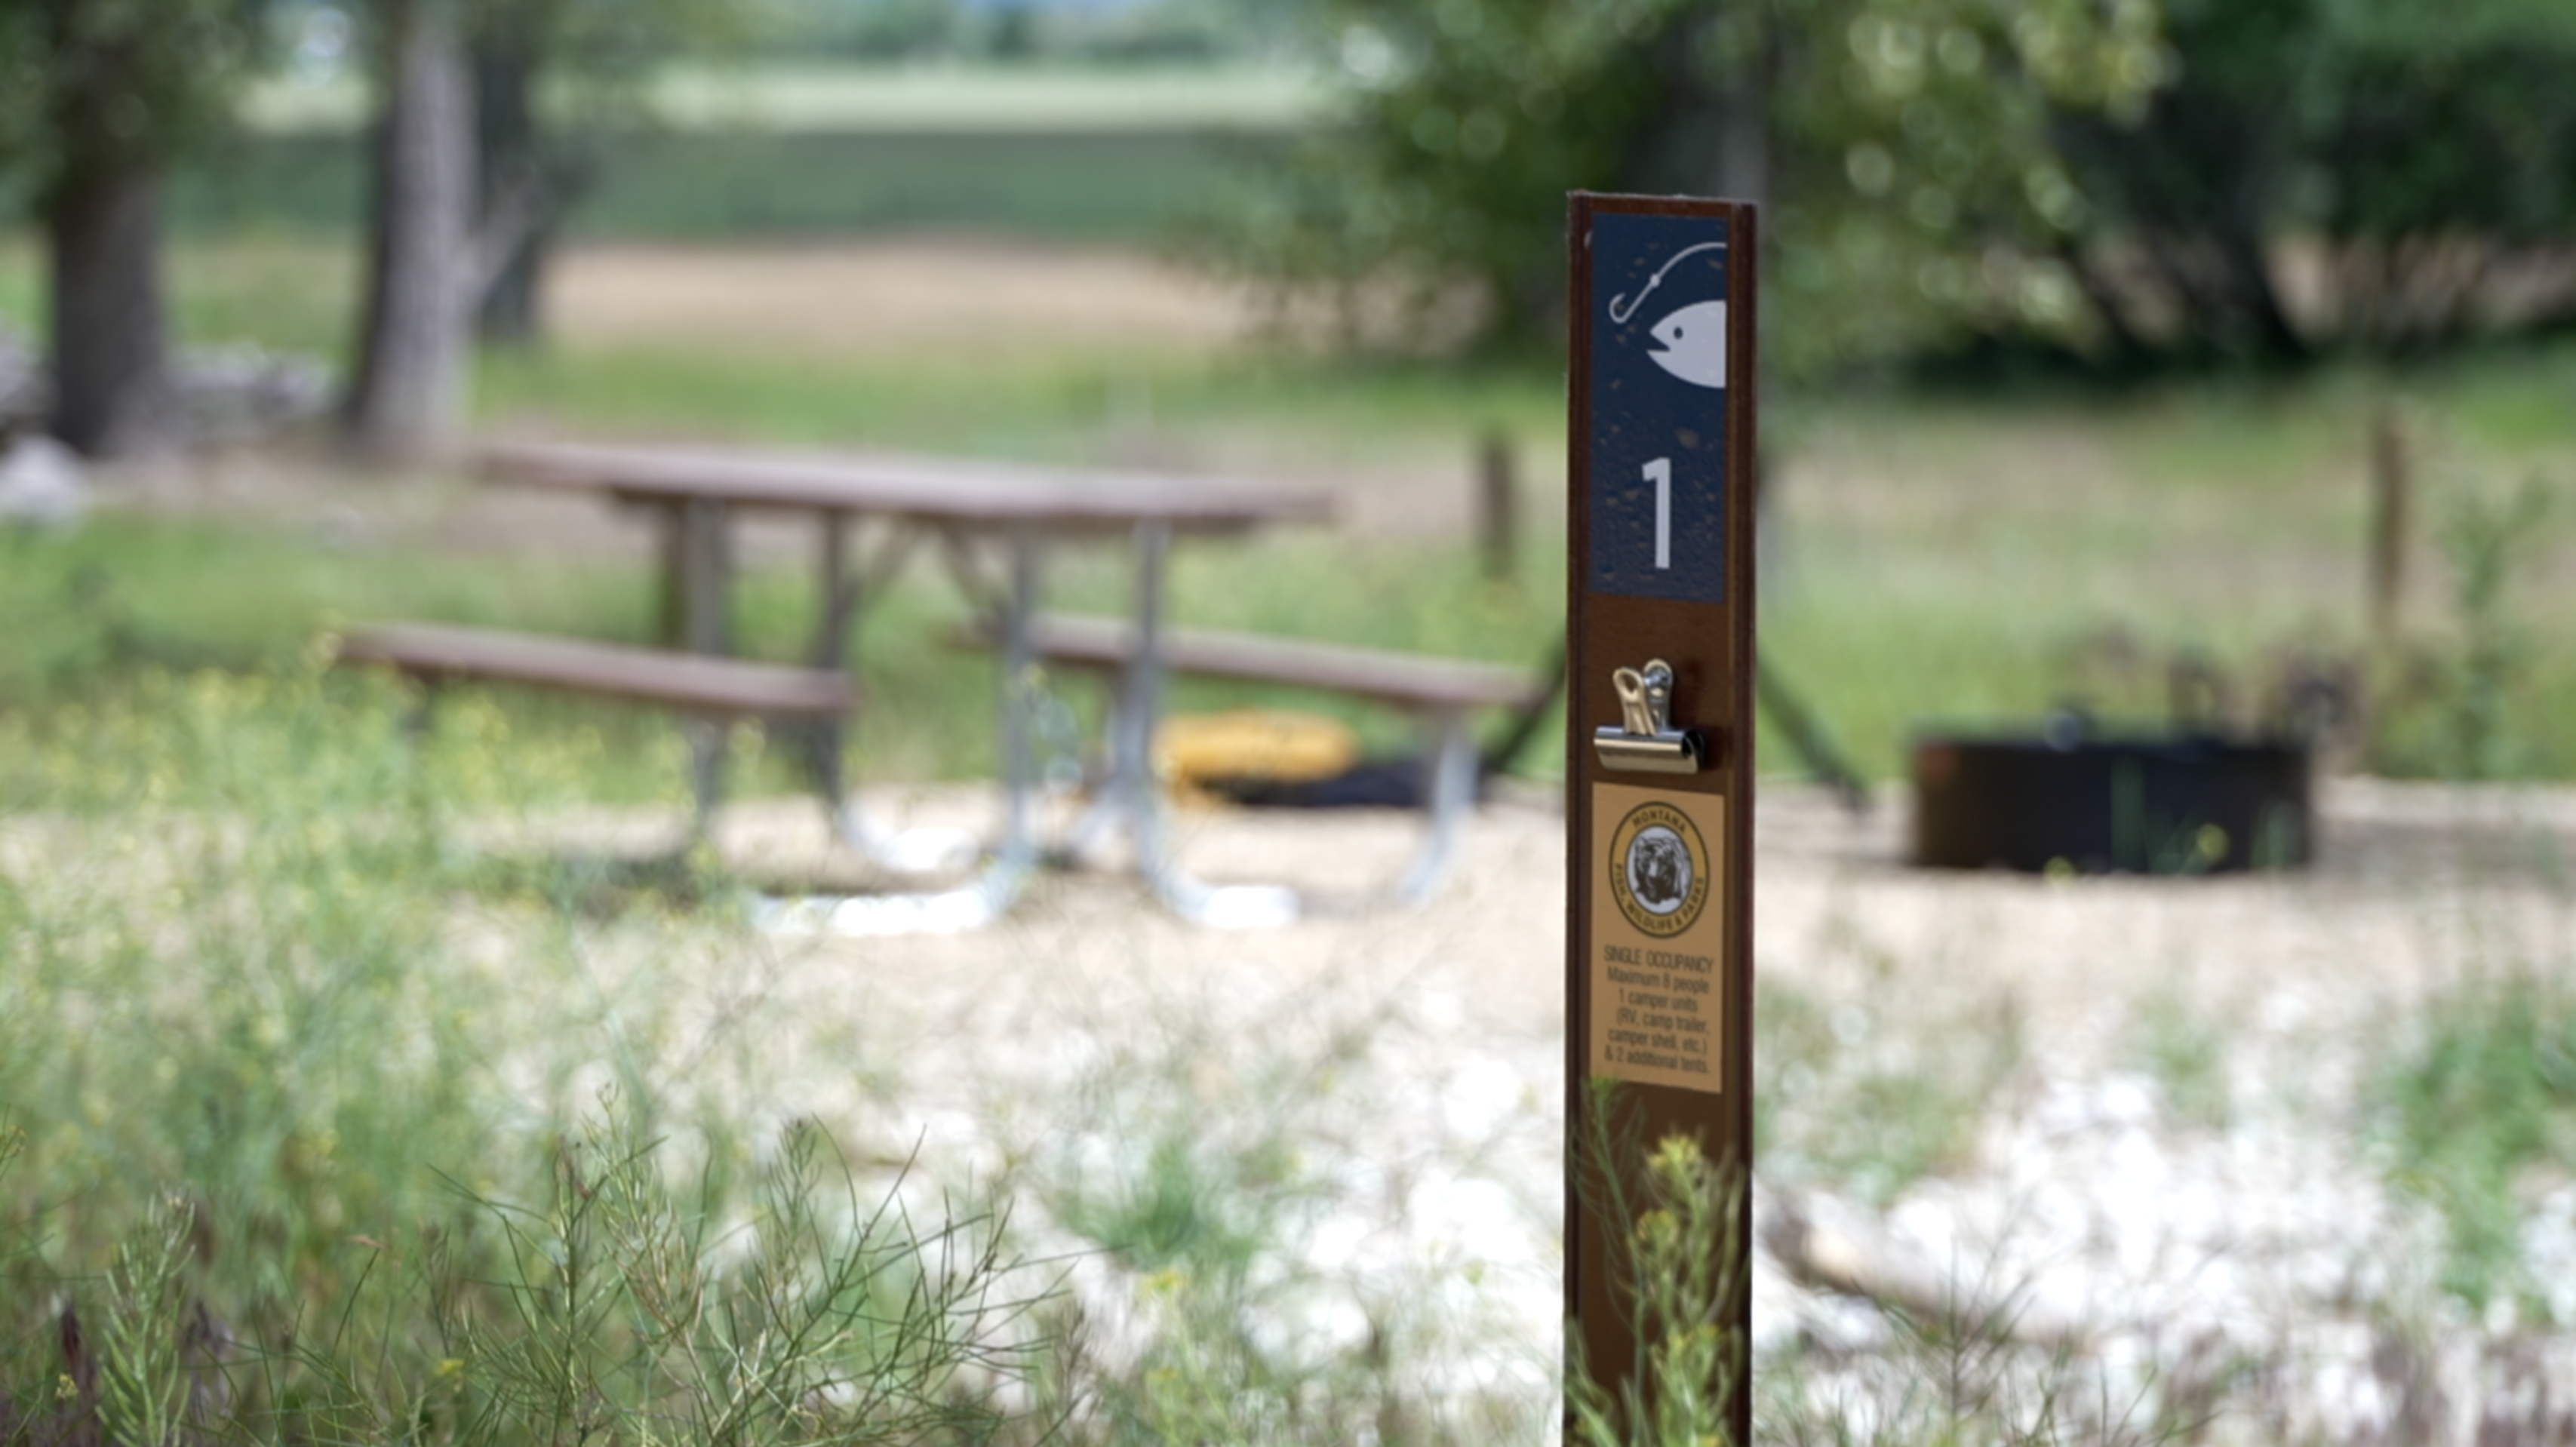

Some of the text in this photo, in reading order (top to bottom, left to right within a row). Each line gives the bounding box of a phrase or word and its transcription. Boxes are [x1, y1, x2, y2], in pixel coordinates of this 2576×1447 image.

[1642, 457, 1670, 569] 1
[1632, 810, 1686, 834] MONTANA
[1627, 900, 1672, 930] WILDLIFE
[1674, 915, 1683, 927] &
[1682, 877, 1704, 919] PARKS
[1604, 945, 1714, 974] SINGLE OCCUPANCY
[1607, 966, 1710, 994] Maximum 8 people
[1618, 988, 1698, 1011] 1 camper units
[1616, 1006, 1710, 1036] (RV, camp trailer,
[1608, 1028, 1647, 1046] camper
[1683, 1037, 1707, 1056] etc.)
[1604, 1044, 1612, 1061] &
[1616, 1046, 1624, 1062] 2
[1627, 1050, 1678, 1069] additional
